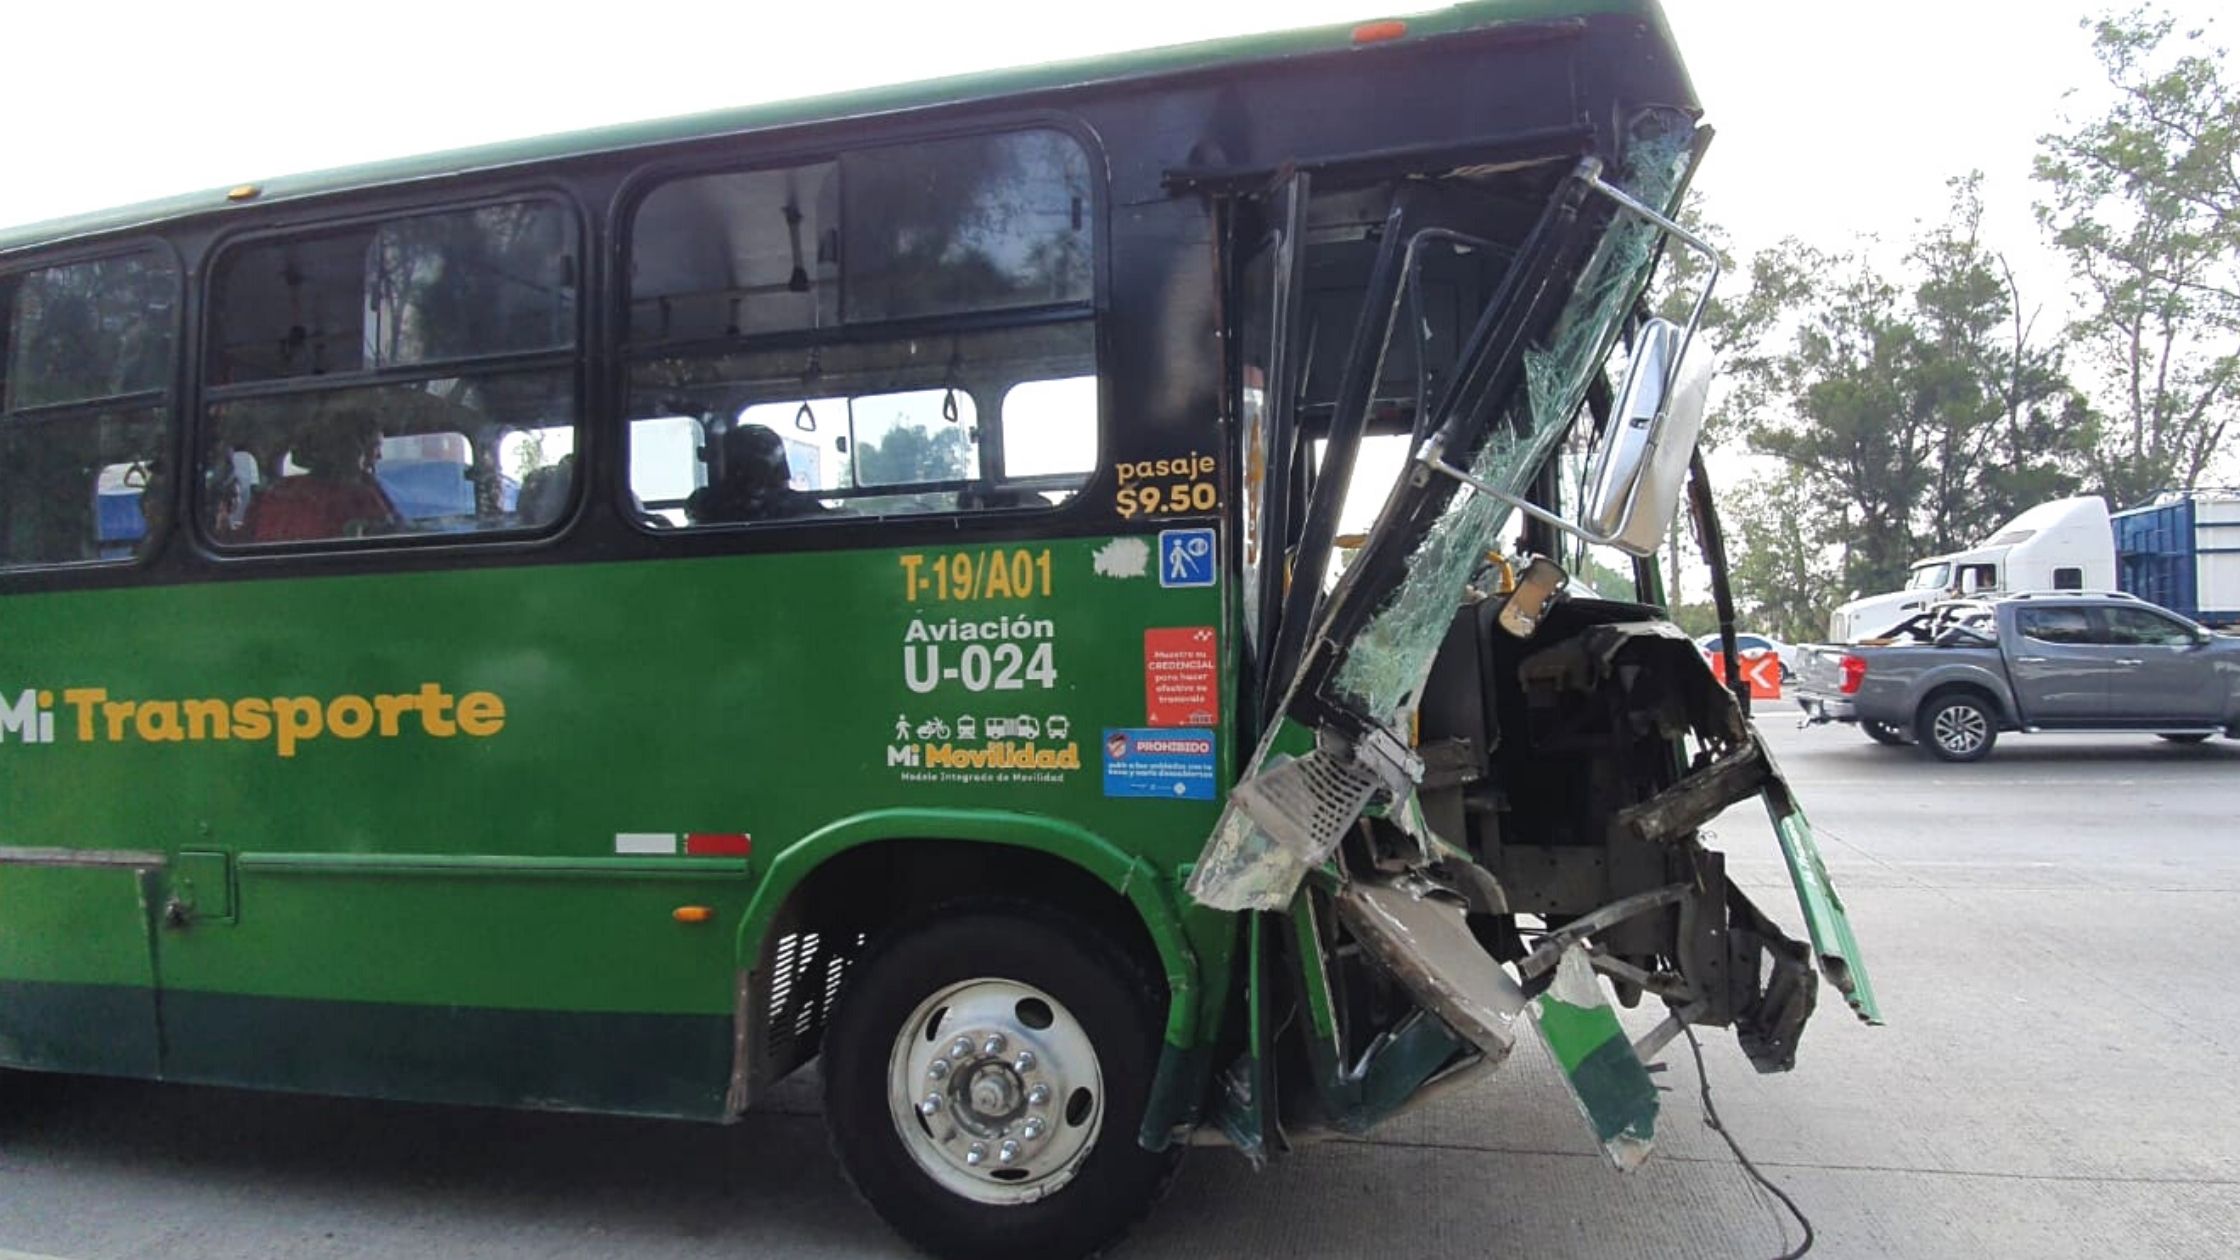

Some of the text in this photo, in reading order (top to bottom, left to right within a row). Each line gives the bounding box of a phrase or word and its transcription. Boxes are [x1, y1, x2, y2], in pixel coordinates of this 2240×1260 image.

[1115, 450, 1216, 486] pasaje
[1116, 482, 1217, 519] $9.50
[900, 549, 1051, 602] T-19/A01
[905, 614, 1055, 642] Aviación
[903, 643, 1058, 693] U-024
[1148, 660, 1215, 670] CREDENCIAL
[0, 682, 506, 757] Mi Transporte
[887, 741, 1081, 769] Mi Movilidad
[1136, 741, 1210, 753] PROHIBIDO
[901, 771, 938, 781] Modelo
[1013, 771, 1064, 783] Movilidad
